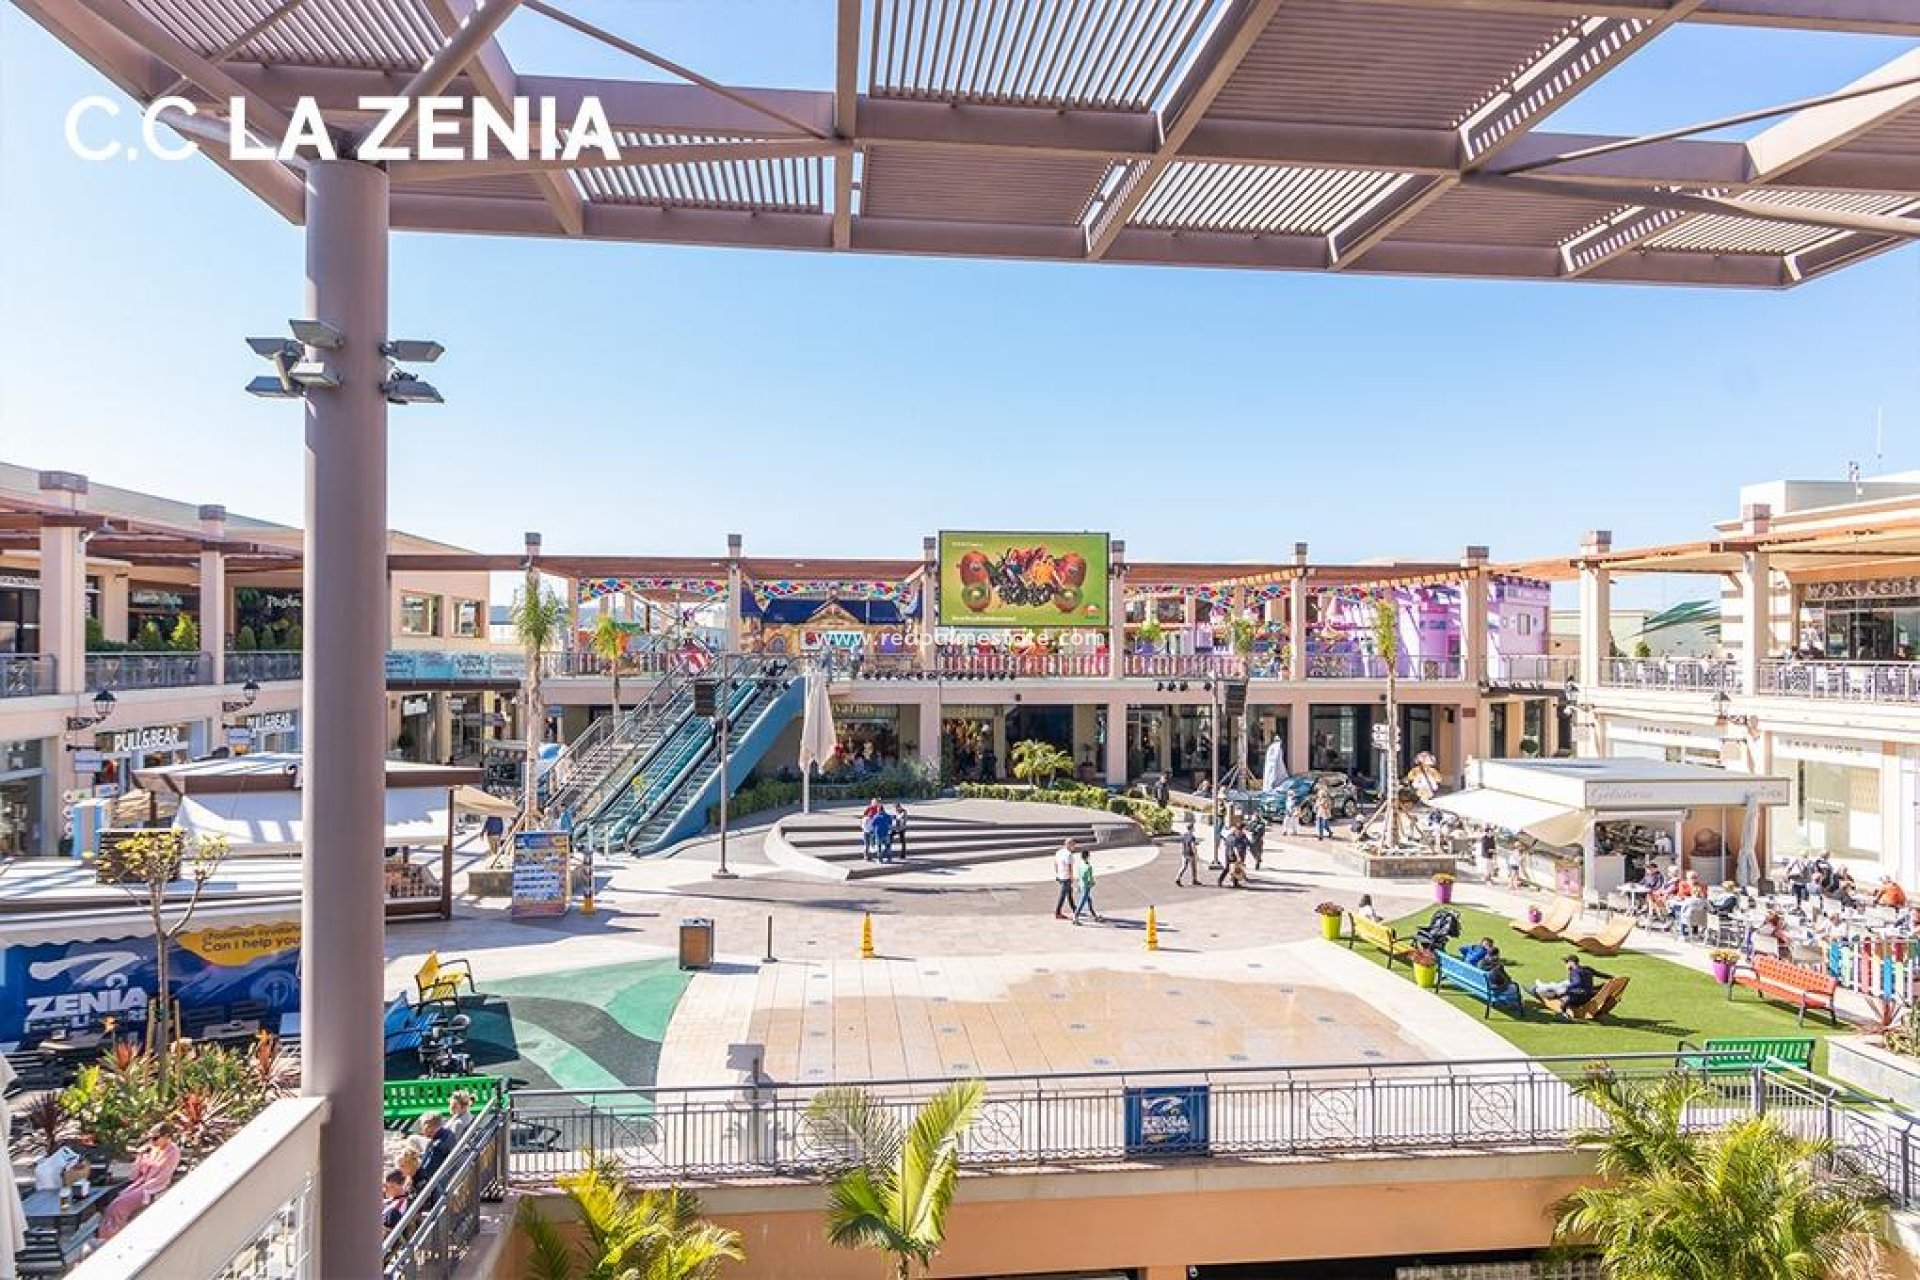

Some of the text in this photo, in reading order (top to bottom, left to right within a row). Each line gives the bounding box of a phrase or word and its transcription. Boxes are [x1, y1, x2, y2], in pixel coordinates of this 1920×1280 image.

[114, 726, 180, 752] PULL&BEAR
[202, 937, 231, 952] Can
[242, 937, 272, 950] help
[26, 987, 148, 1022] ZENIA
